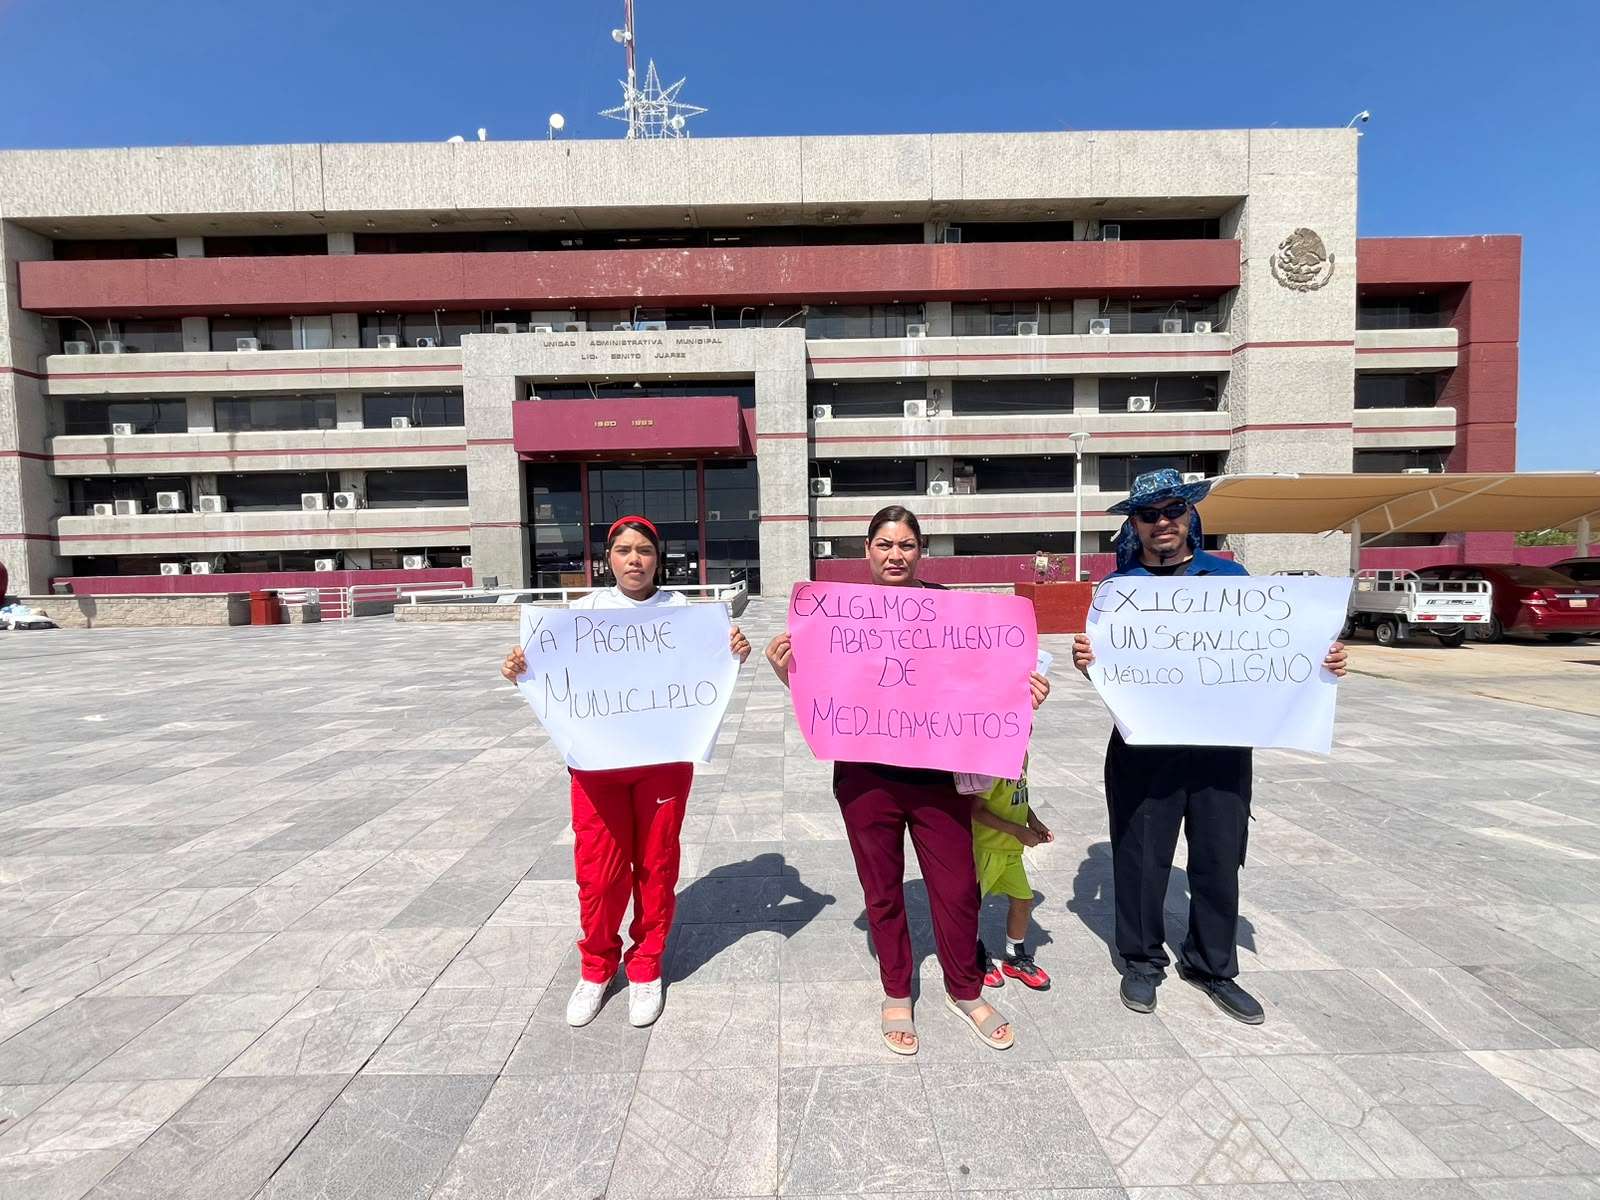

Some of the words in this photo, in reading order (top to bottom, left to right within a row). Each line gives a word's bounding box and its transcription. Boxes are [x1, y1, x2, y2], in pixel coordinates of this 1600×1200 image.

[543, 340, 576, 348] UNIDAD
[589, 339, 663, 347] ADMINISTRATIVA
[675, 337, 723, 345] MUNICIPAL
[793, 584, 937, 622] EXIGIMOS
[1093, 580, 1291, 621] EXIGIMOS
[523, 615, 558, 653] YA
[574, 615, 676, 654] PÁGAME
[829, 624, 1025, 654] ABASTECIMIENTO
[1110, 623, 1148, 650] UN
[1152, 624, 1290, 651] SERVICIO
[878, 656, 917, 688] DE
[1198, 653, 1312, 687] DIGNO
[544, 667, 718, 719] MUNICIPIO
[811, 697, 1020, 740] MEDICAMENTOS
